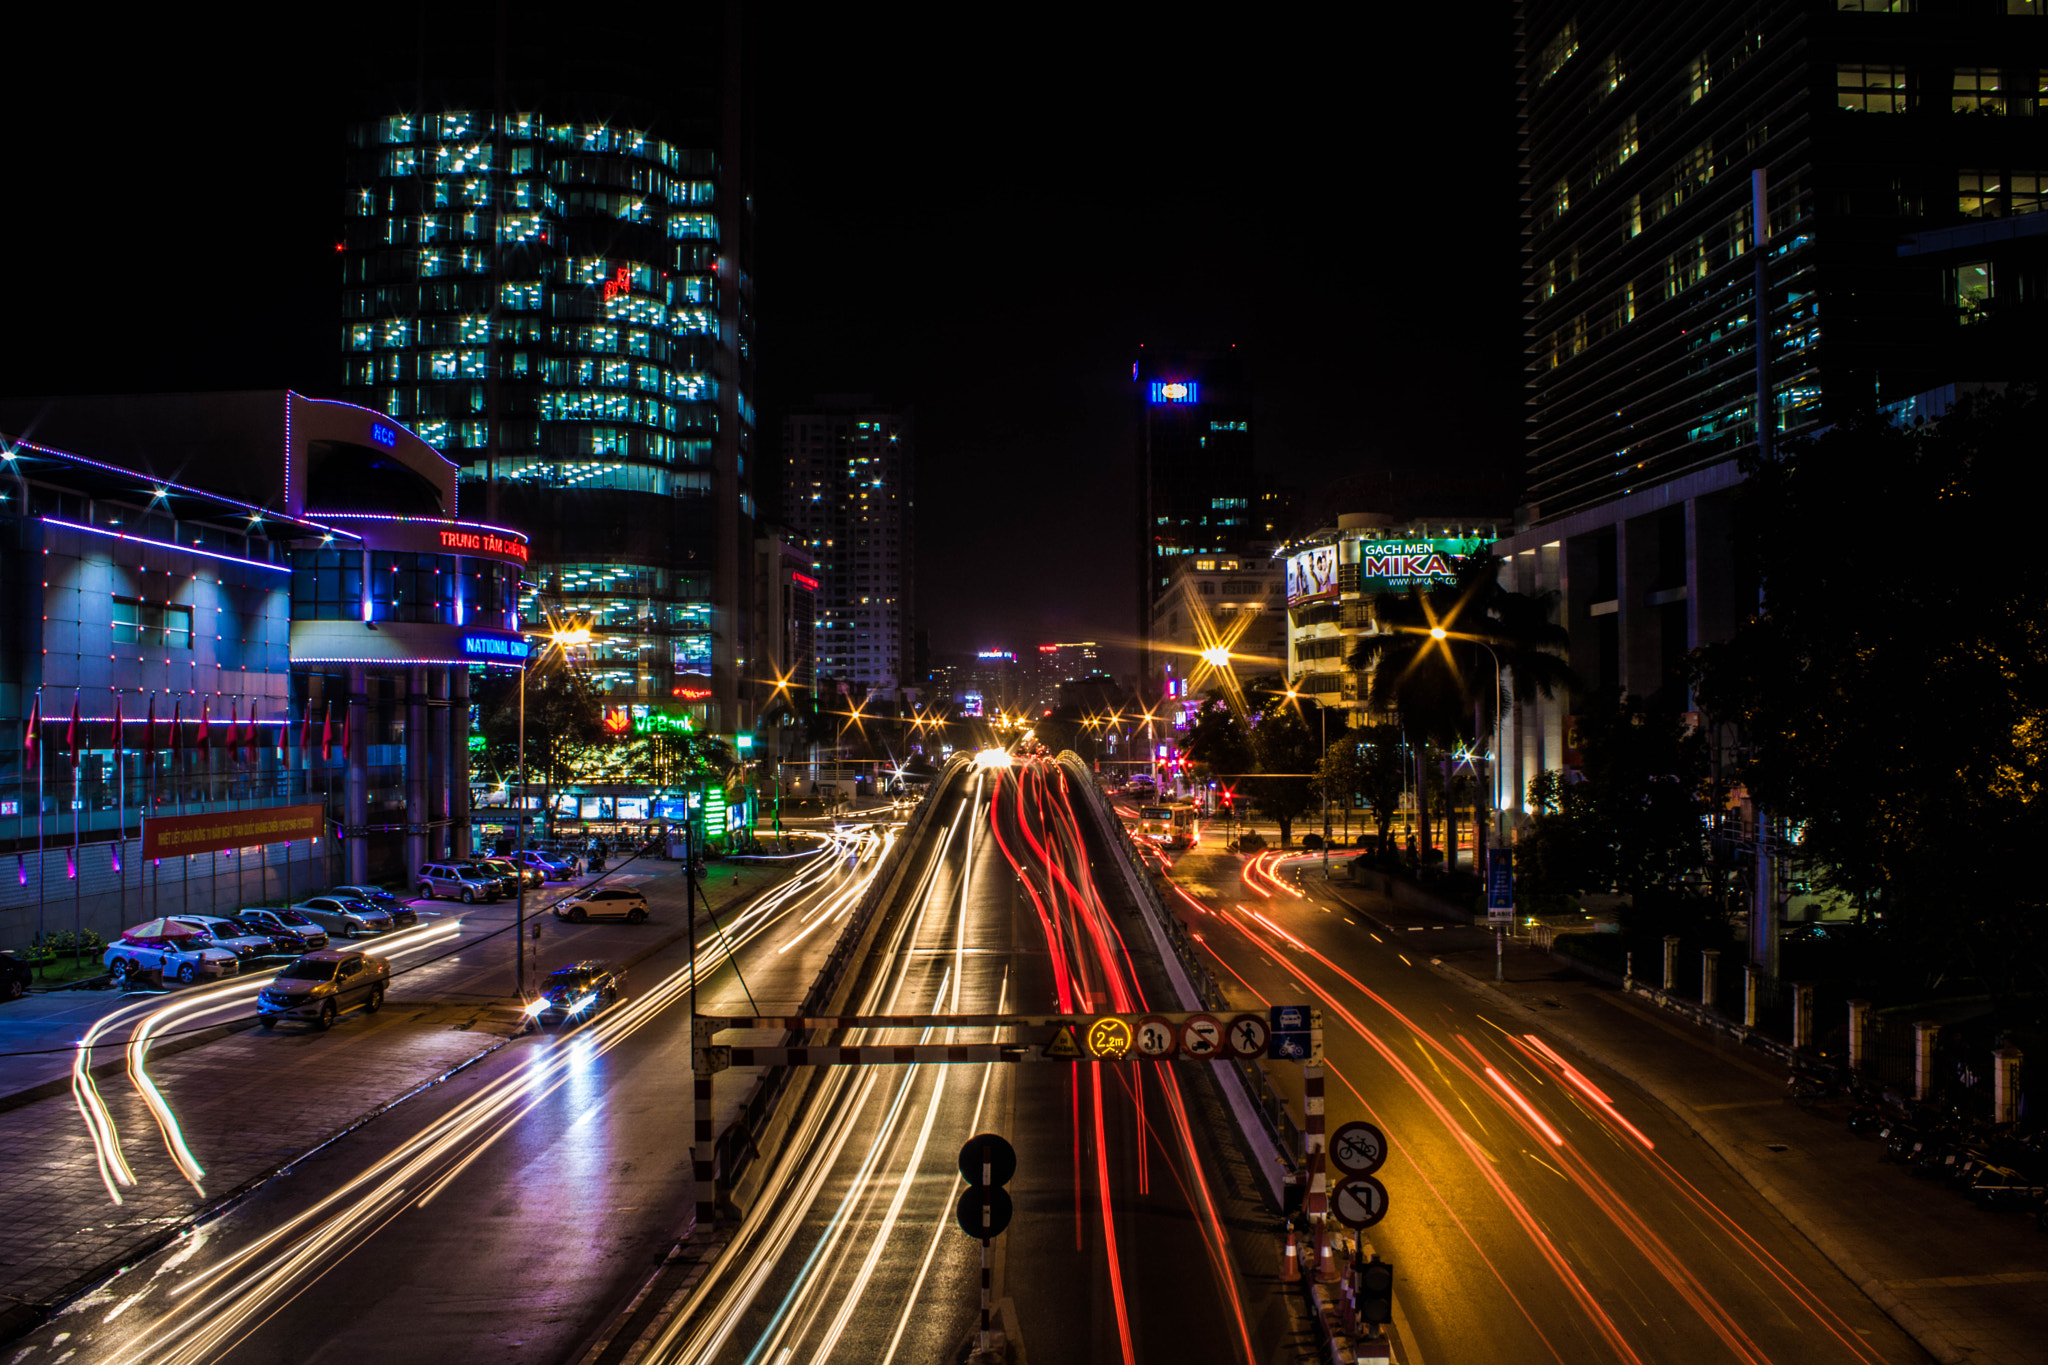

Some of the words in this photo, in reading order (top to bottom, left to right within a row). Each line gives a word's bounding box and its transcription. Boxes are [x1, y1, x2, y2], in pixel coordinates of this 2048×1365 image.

[440, 531, 480, 549] TRUNG
[483, 534, 503, 553] TÂM
[1365, 545, 1402, 557] GẠCH
[1405, 544, 1434, 554] MEN
[1365, 554, 1470, 578] MIKA
[466, 638, 509, 655] NATIONAL
[634, 715, 693, 732] VPBank
[1097, 1031, 1124, 1048] 2.2m
[1144, 1028, 1163, 1050] 3t
